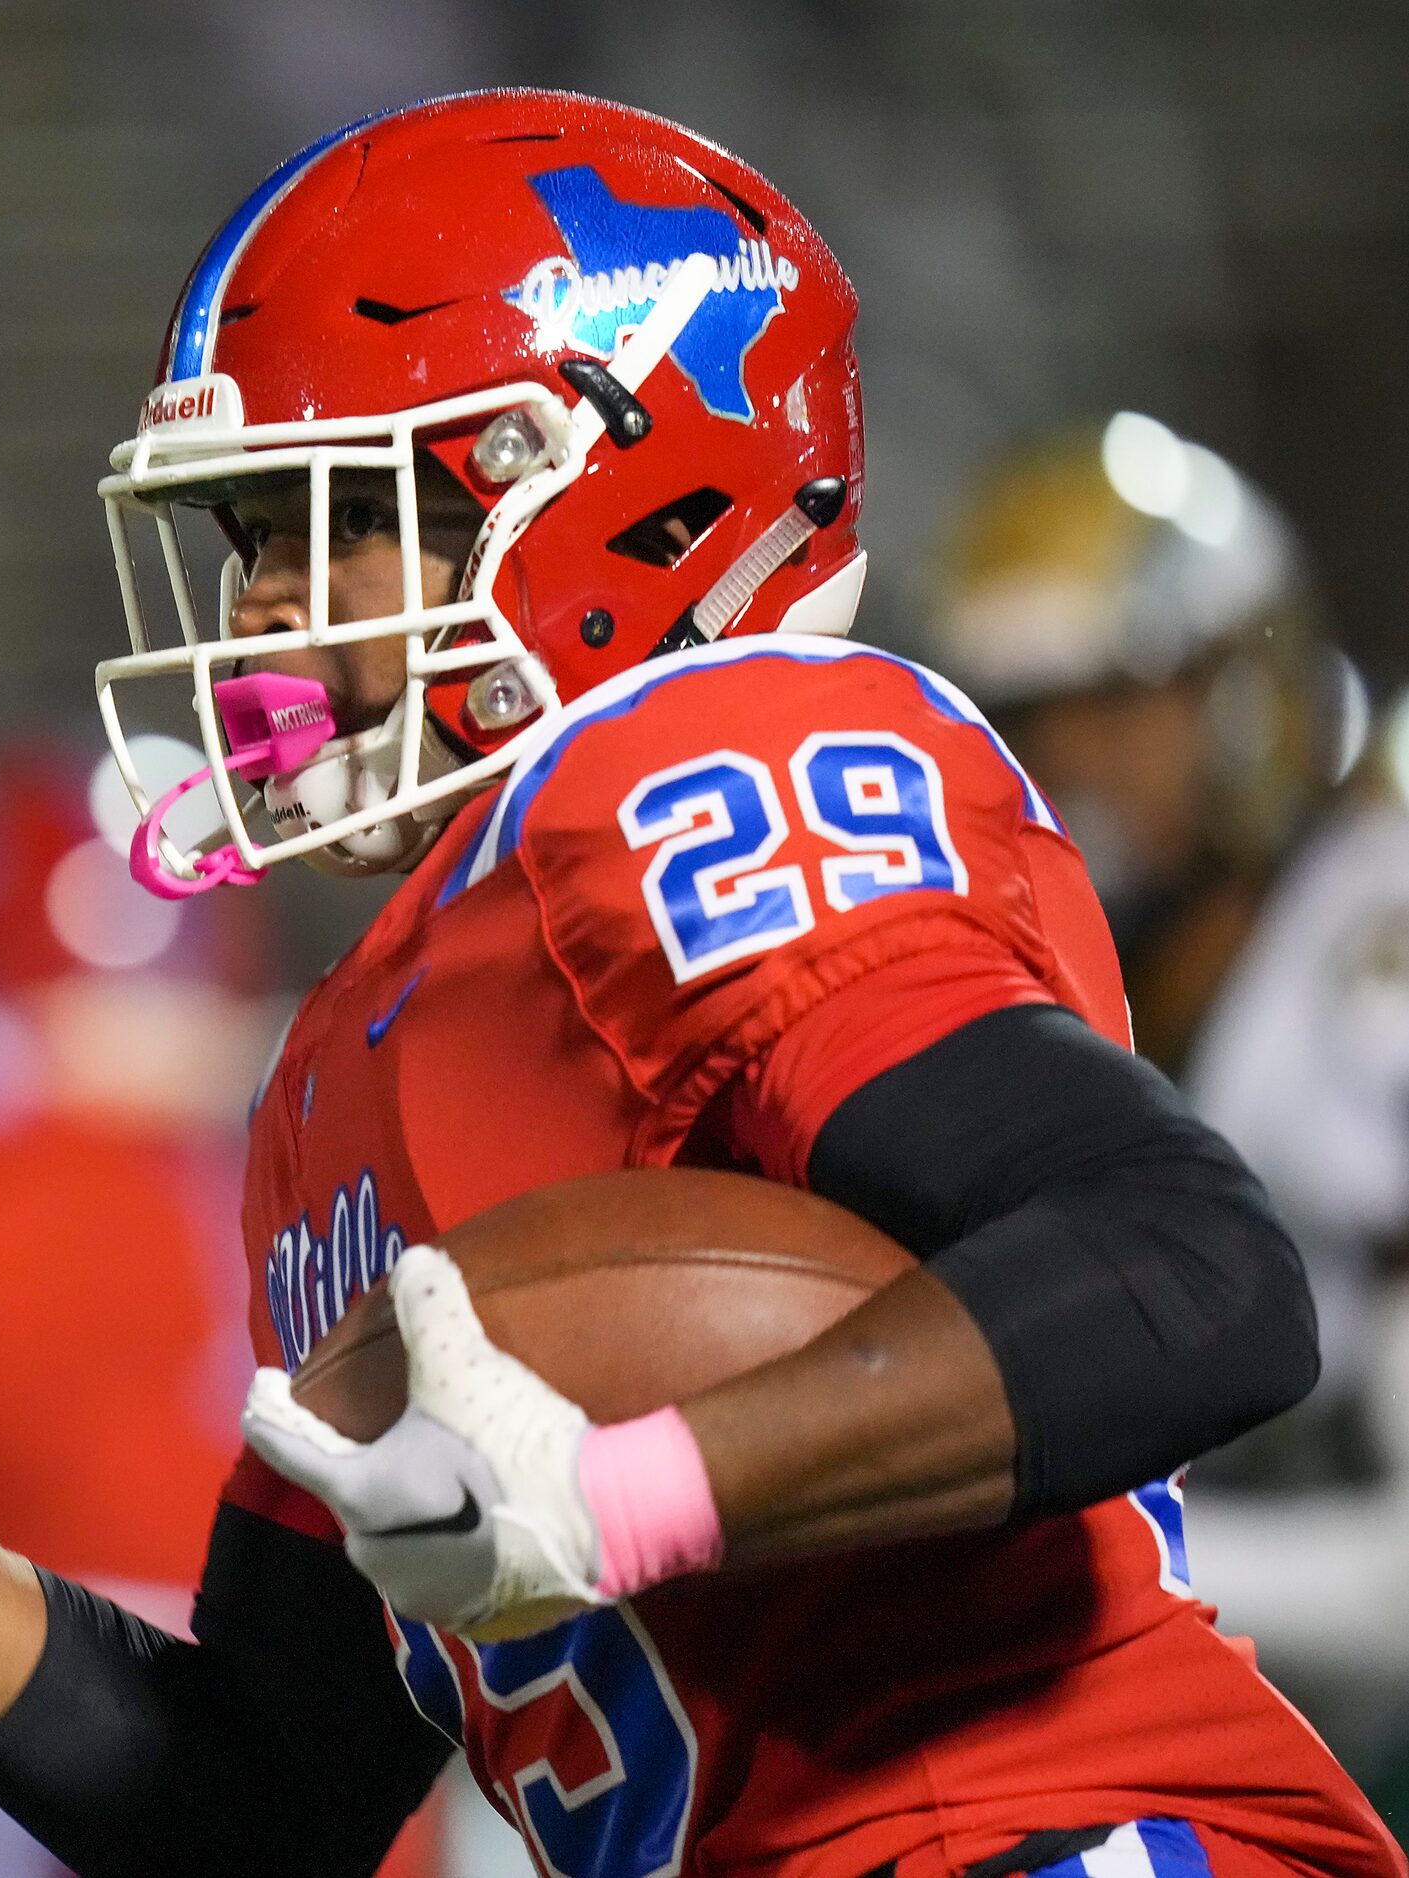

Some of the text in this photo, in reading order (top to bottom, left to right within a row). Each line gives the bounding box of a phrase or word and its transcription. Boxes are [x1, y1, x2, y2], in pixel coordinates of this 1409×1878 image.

[522, 238, 799, 326] Duncville
[271, 699, 327, 734] NXTRND
[616, 729, 970, 987] 29
